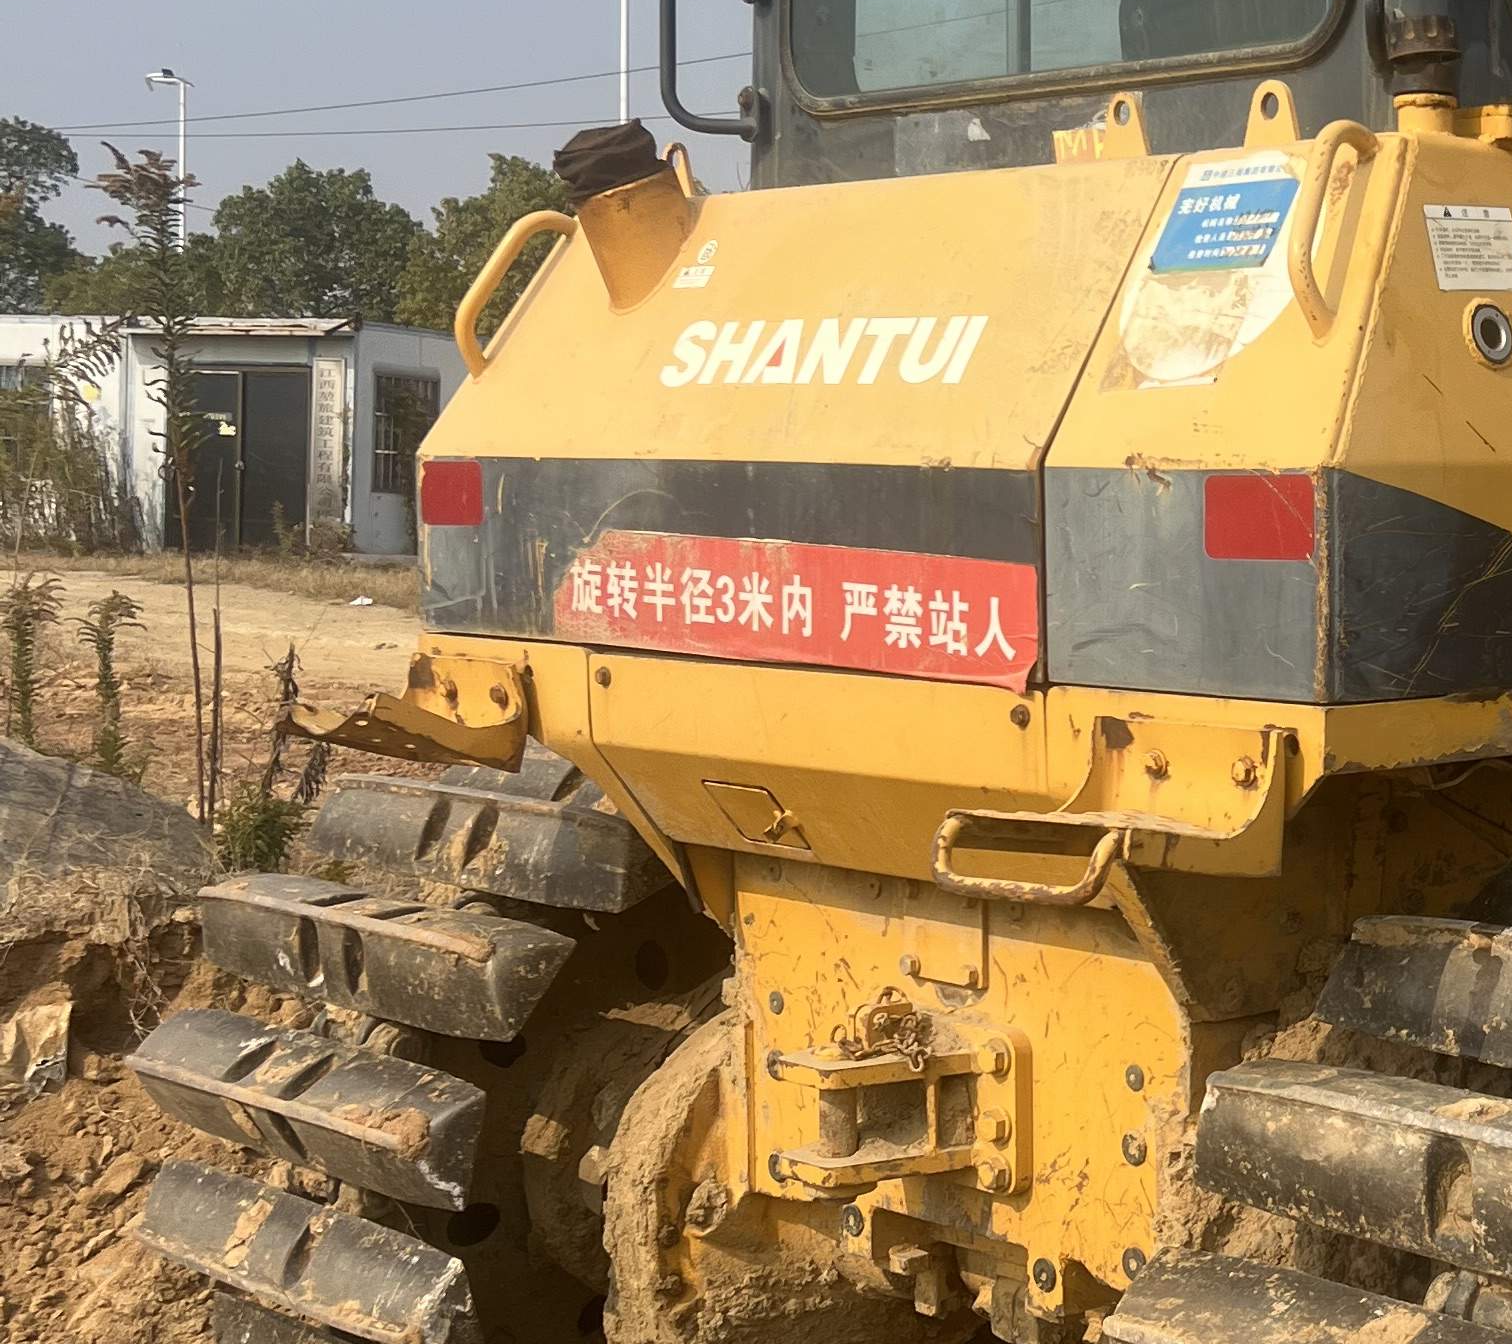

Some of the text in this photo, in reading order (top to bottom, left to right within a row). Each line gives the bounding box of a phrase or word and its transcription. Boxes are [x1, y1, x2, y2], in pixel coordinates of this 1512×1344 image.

[659, 315, 990, 388] SHANTUI
[569, 559, 1017, 662] 旋转半径3米内 严禁站人
